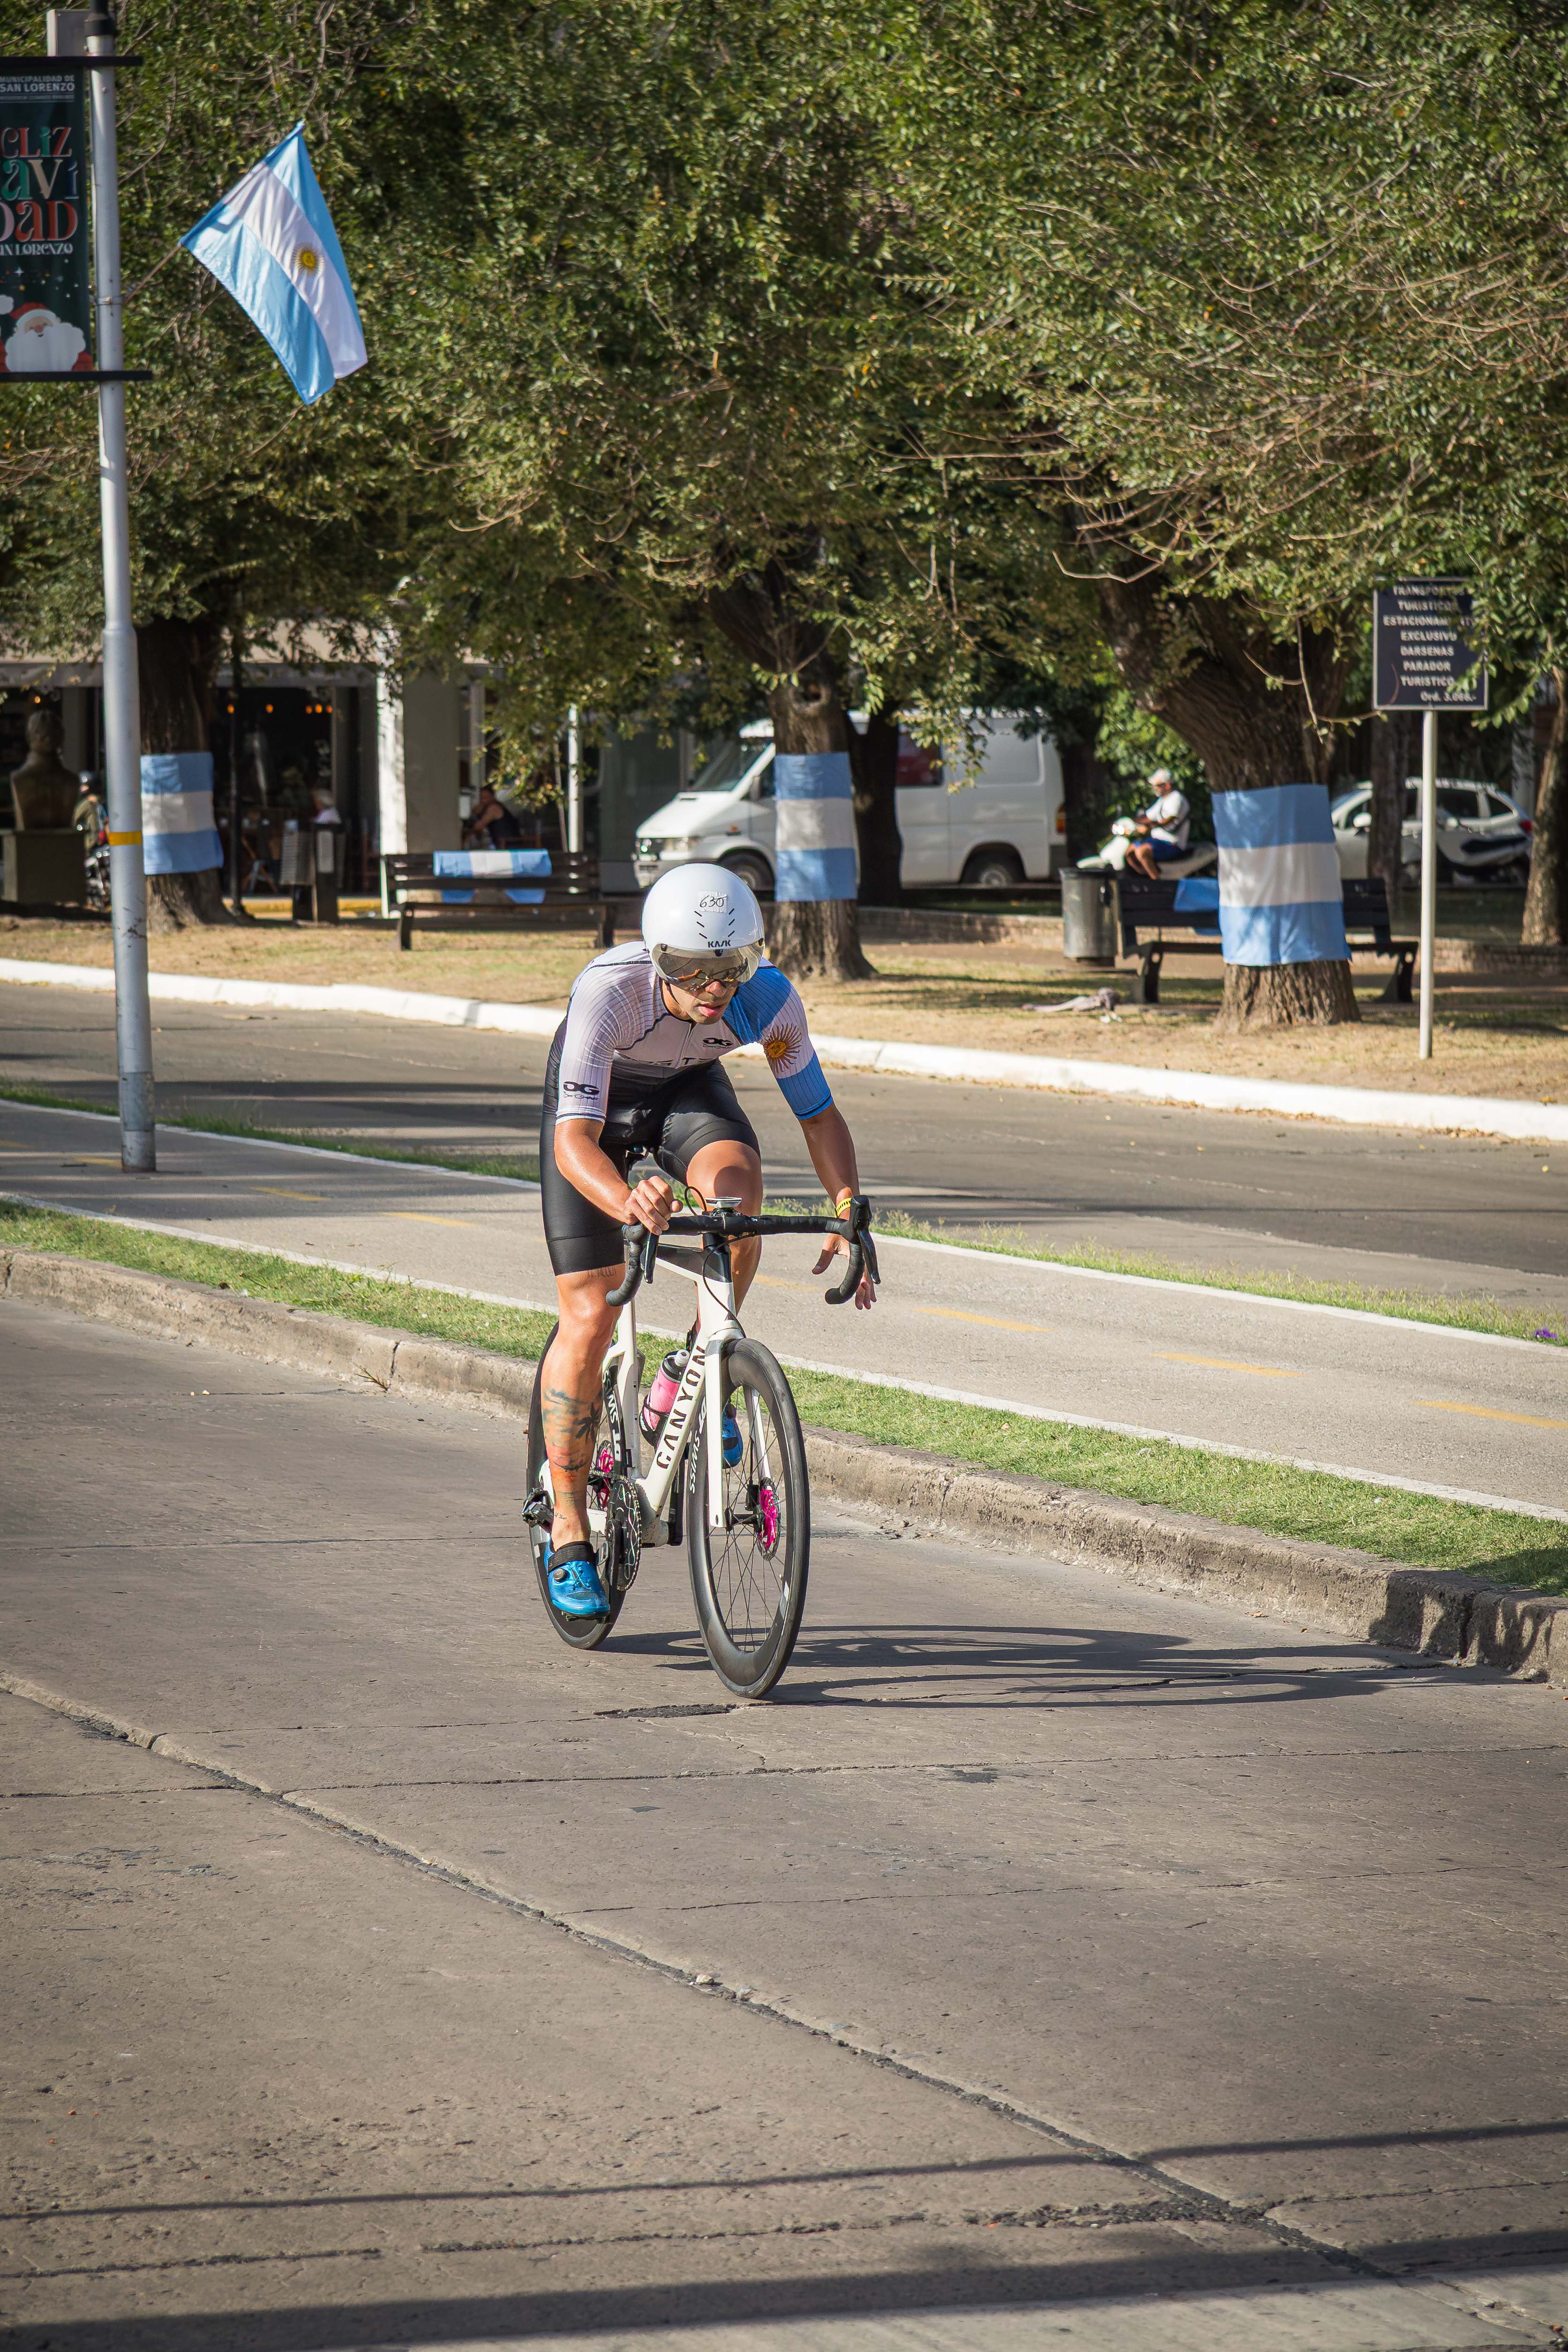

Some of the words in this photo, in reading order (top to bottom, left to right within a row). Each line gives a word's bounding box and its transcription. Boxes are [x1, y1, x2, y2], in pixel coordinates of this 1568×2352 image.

[0, 84, 21, 92] SAN
[24, 83, 75, 92] LORENZO
[1400, 630, 1457, 641] EXCLUSIVO
[1400, 645, 1455, 656] DARSENAS
[1403, 660, 1451, 671] PARADOR
[1400, 675, 1455, 686] TURISTICO
[700, 895, 724, 907] 630
[707, 939, 731, 948] KASK
[656, 1345, 705, 1469] CANYON
[689, 1430, 700, 1494] SWISS
